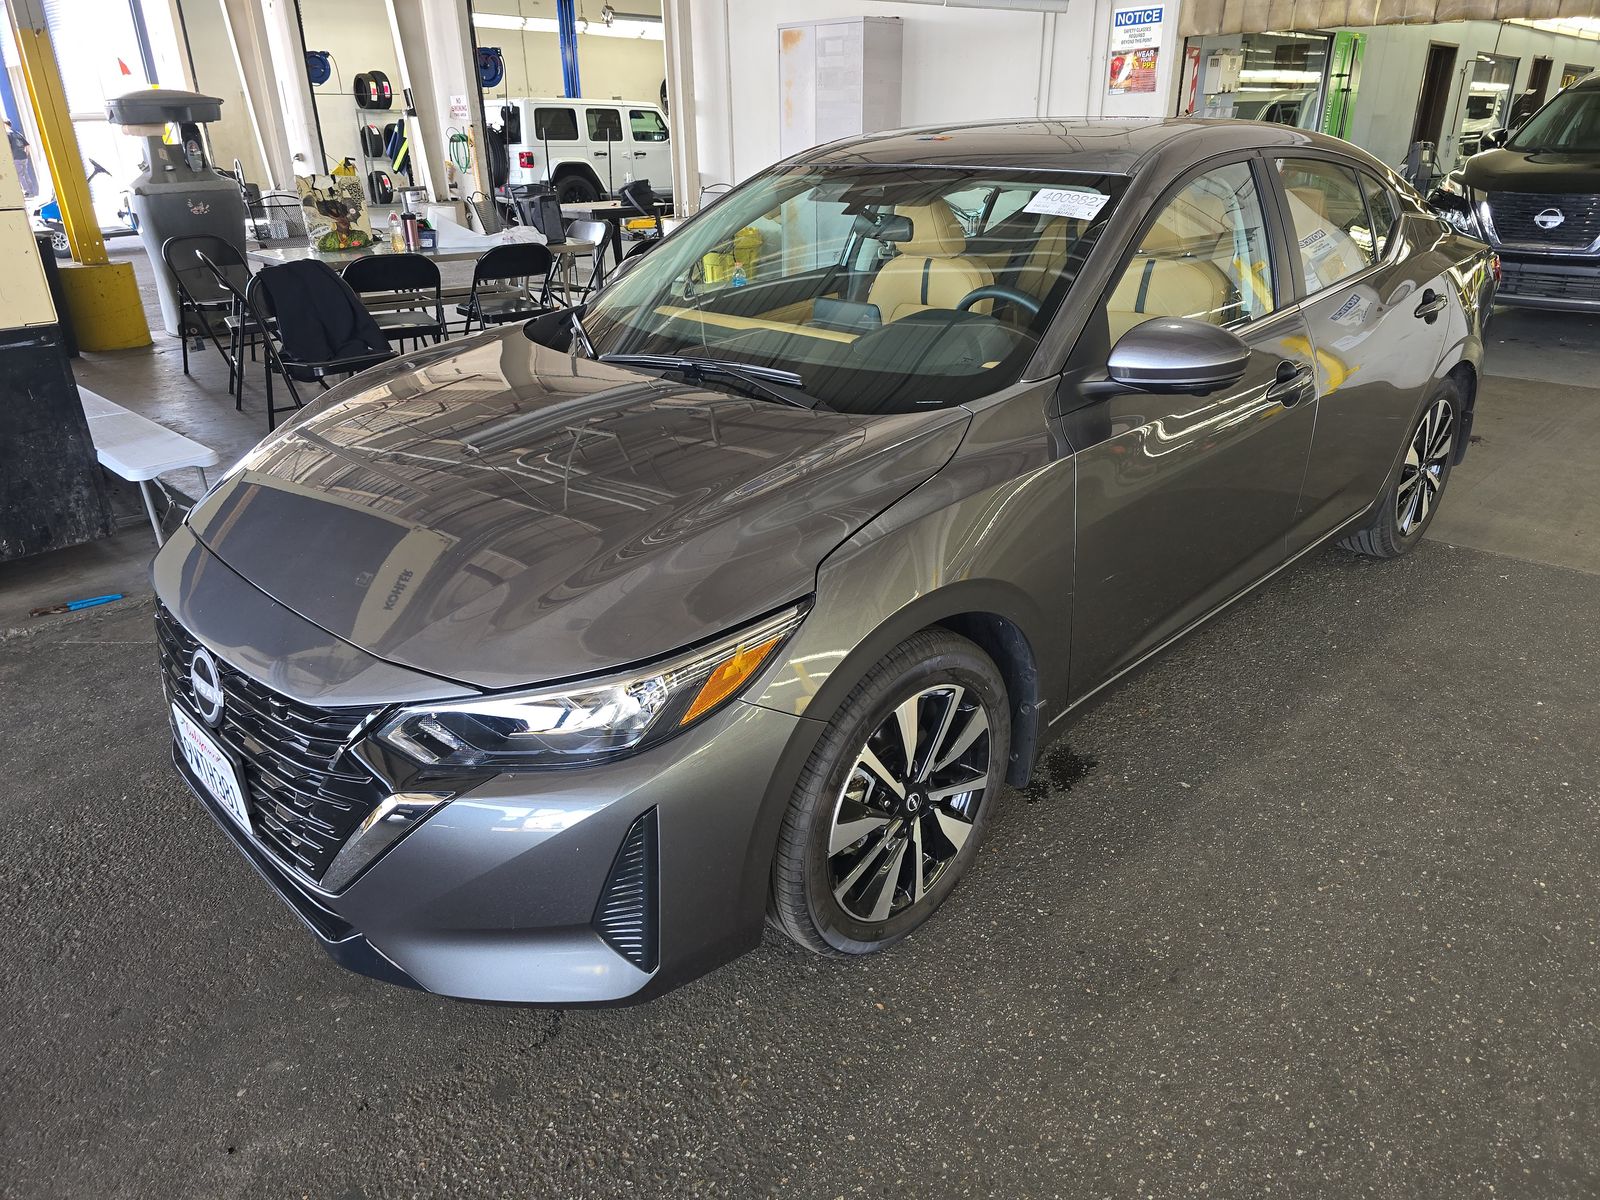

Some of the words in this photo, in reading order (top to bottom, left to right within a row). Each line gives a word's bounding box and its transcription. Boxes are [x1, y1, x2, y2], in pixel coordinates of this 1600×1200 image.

[1117, 10, 1161, 25] NOTICE
[1136, 50, 1155, 58] WEAR
[1043, 192, 1108, 208] 4009827
